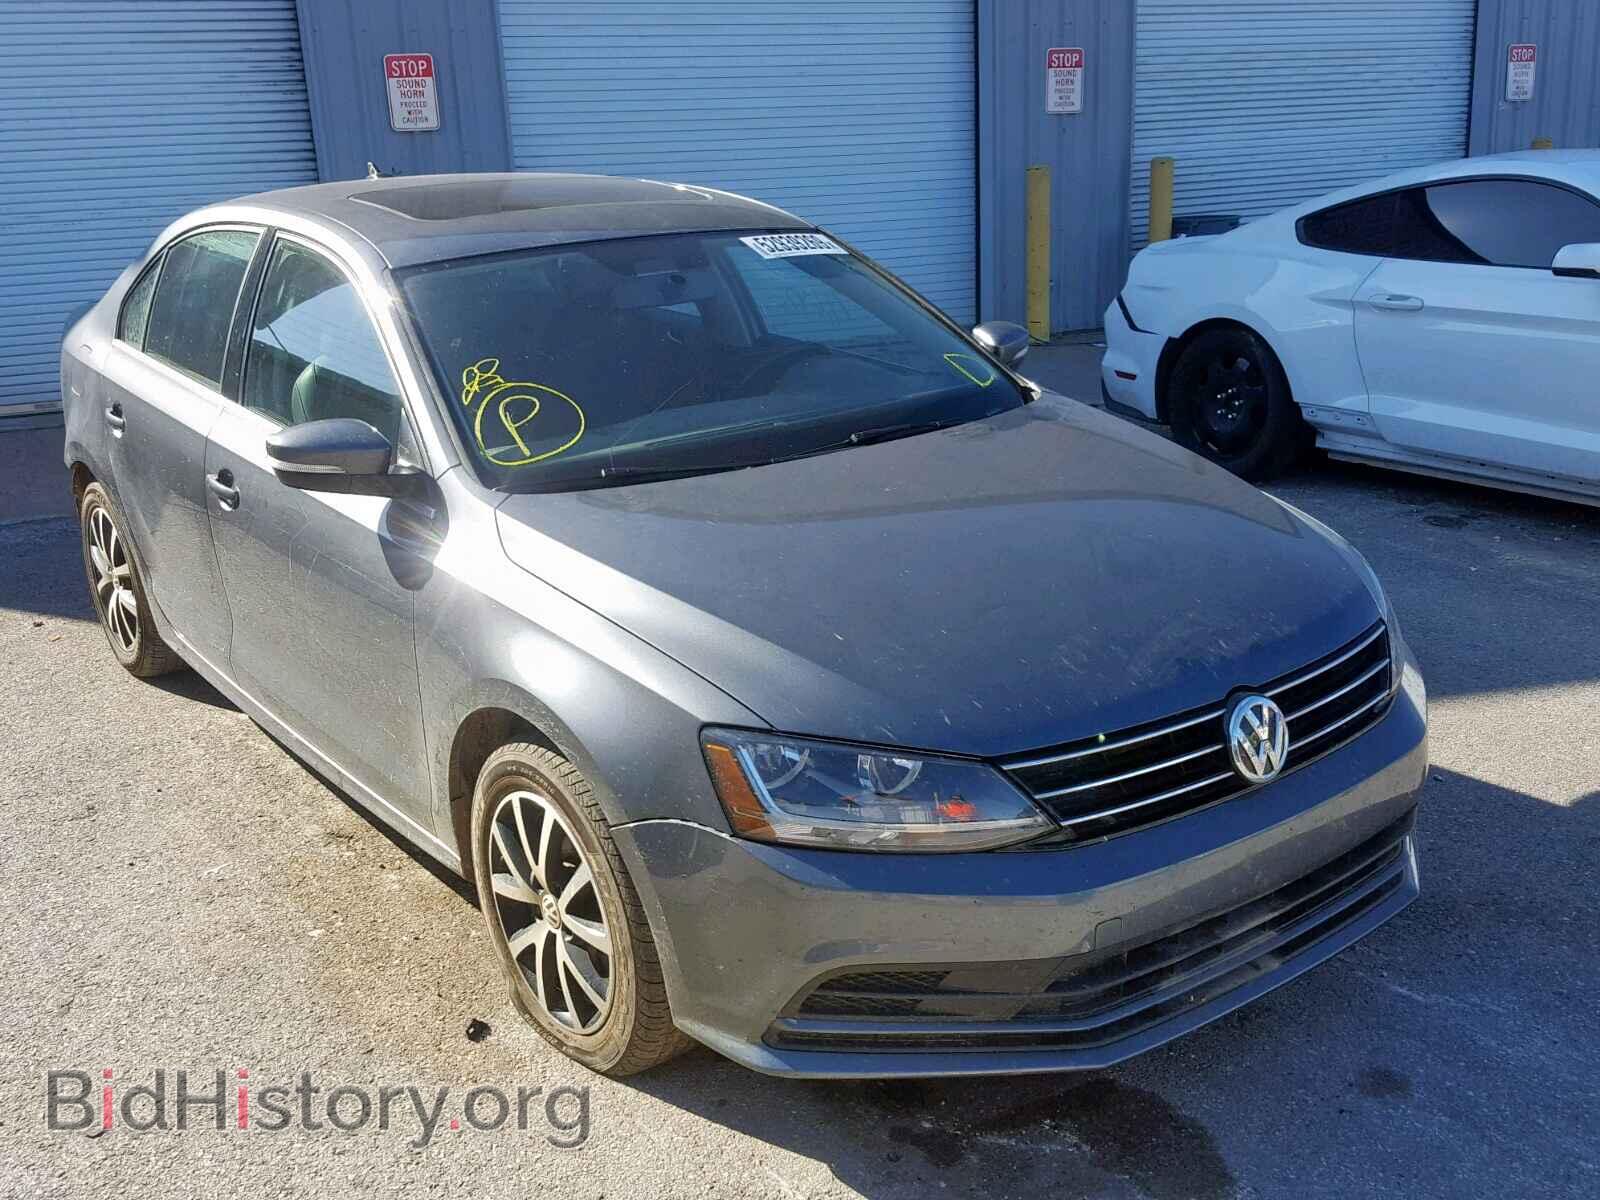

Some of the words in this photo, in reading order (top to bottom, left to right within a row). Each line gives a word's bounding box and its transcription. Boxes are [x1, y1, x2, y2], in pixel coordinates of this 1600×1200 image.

[1051, 53, 1080, 67] STOP
[1512, 48, 1534, 61] STOP
[391, 60, 427, 76] STOP
[396, 79, 426, 88] SOUND
[400, 90, 425, 98] HORN
[753, 235, 832, 253] 52939269
